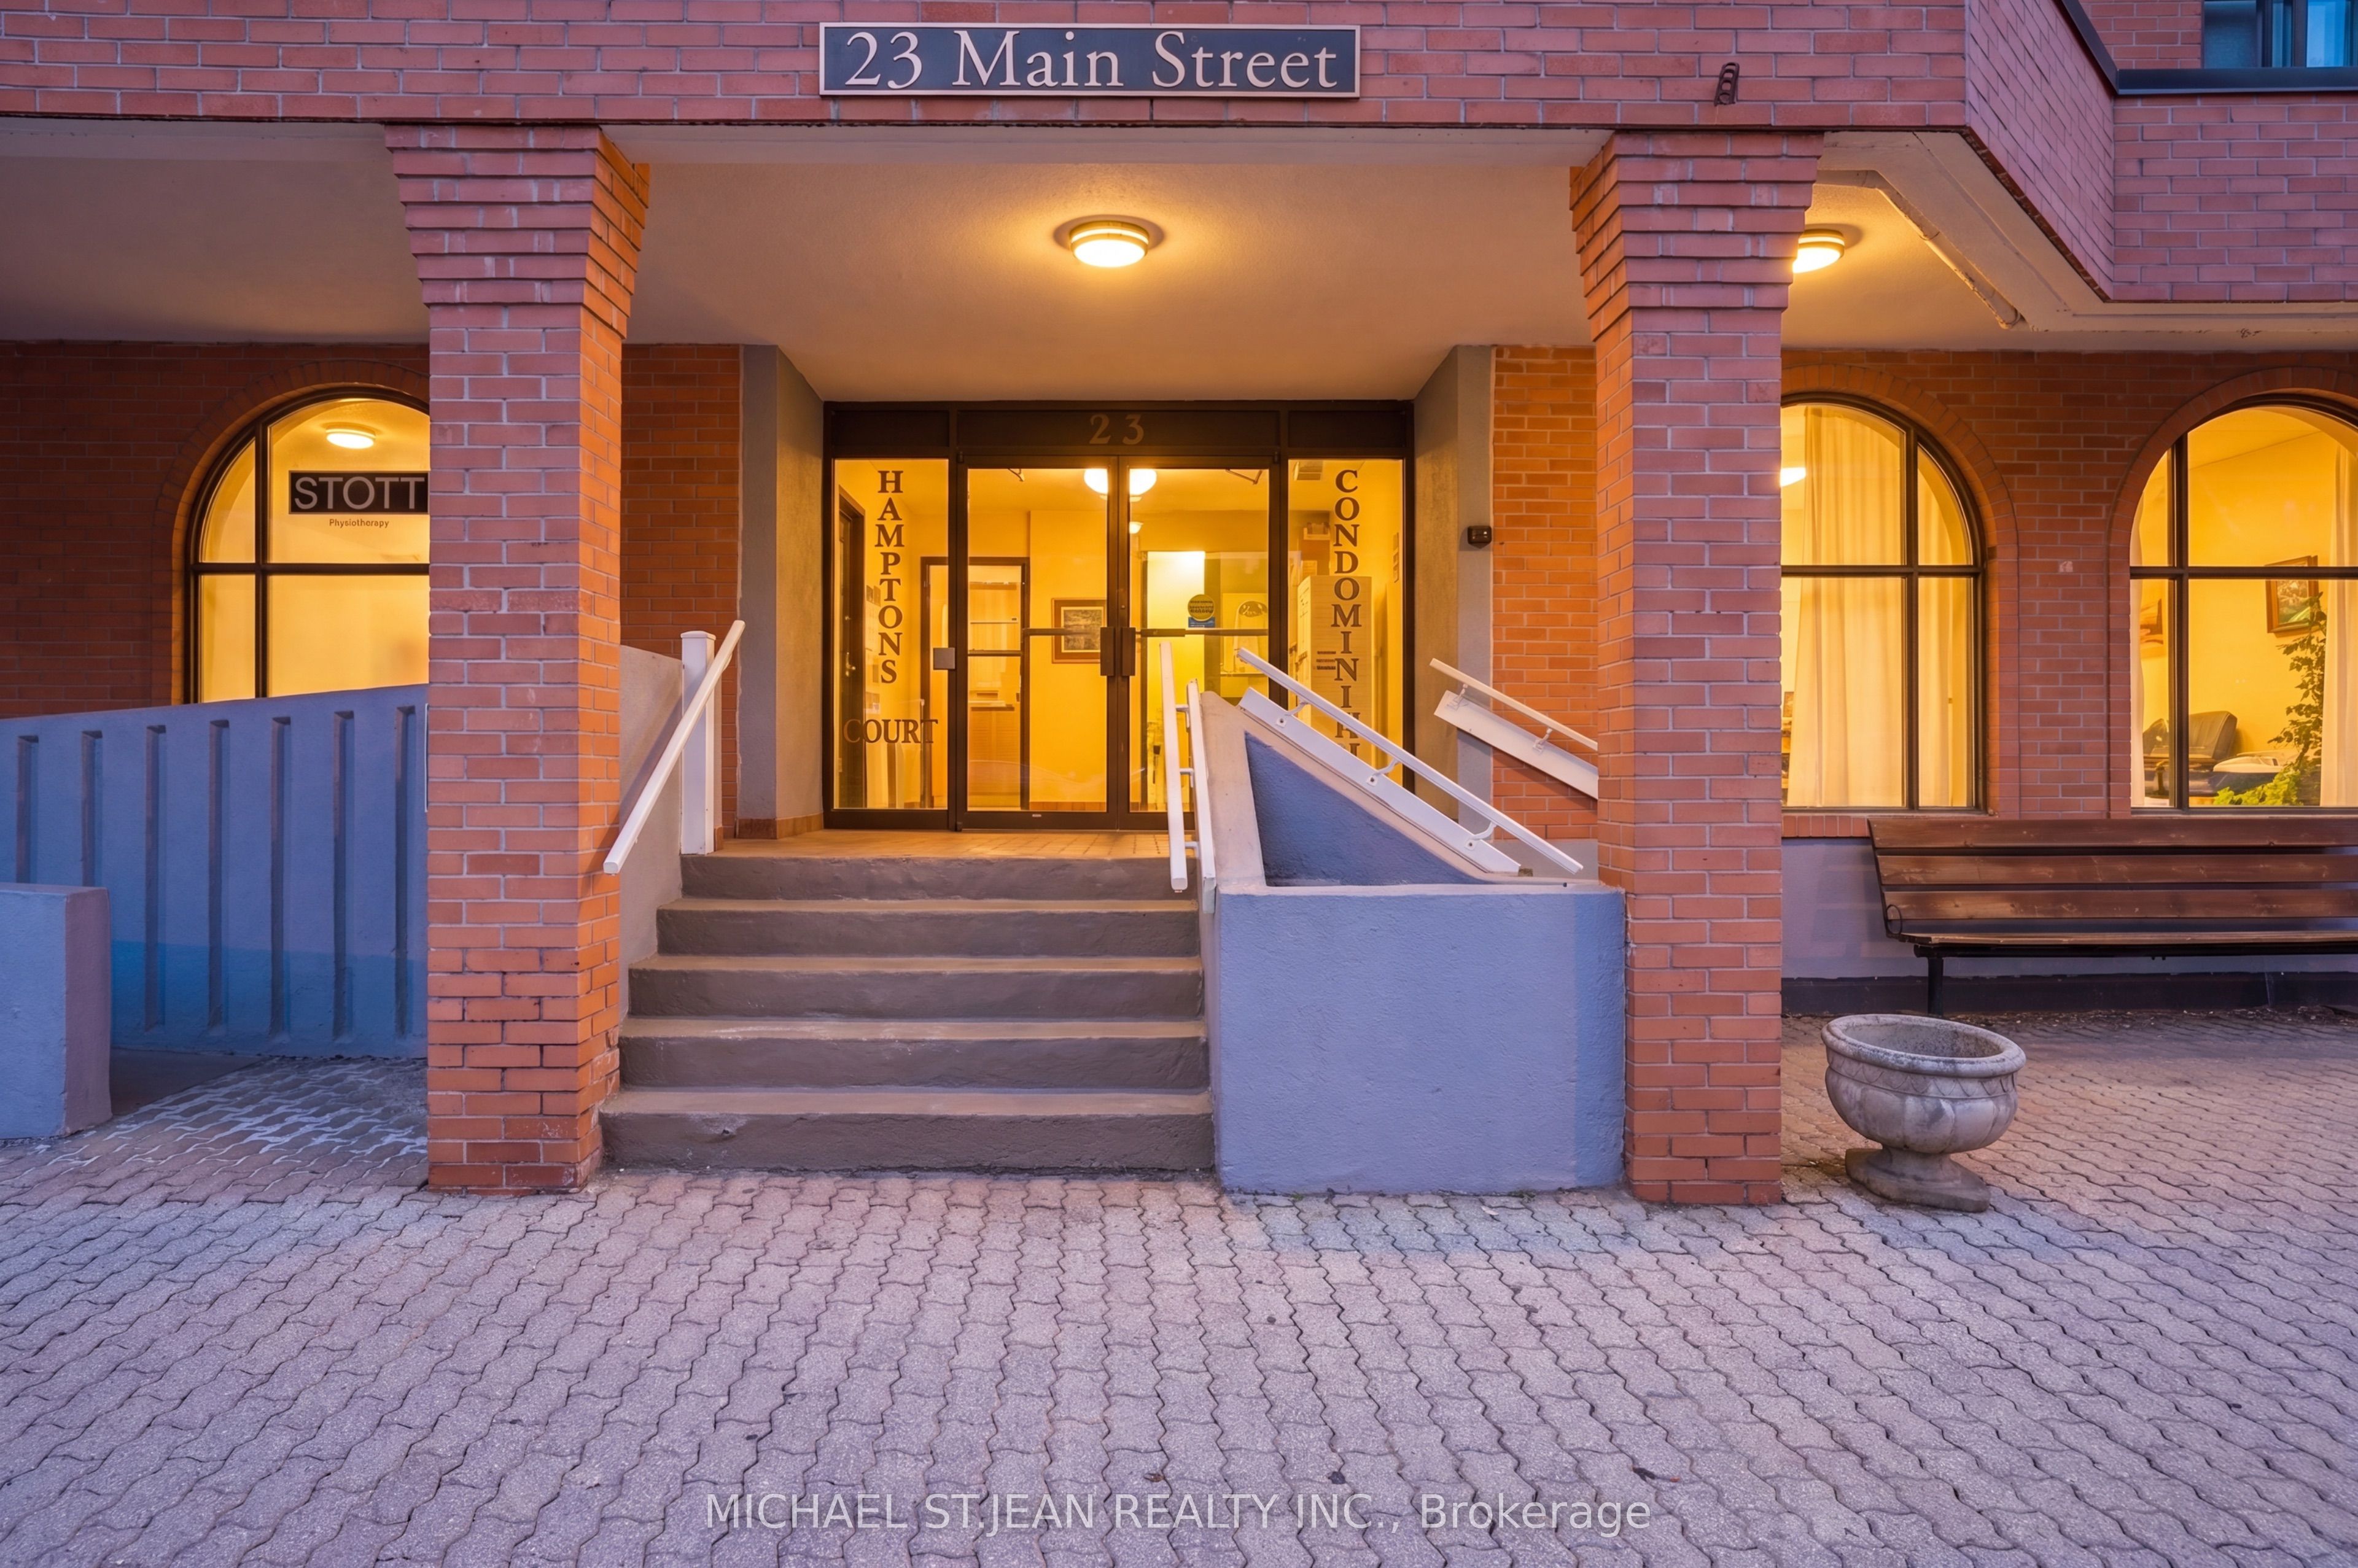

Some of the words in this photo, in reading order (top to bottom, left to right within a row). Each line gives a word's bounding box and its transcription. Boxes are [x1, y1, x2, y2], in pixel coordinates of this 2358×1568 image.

[846, 31, 924, 89] 23
[952, 30, 1124, 88] Main
[1151, 31, 1337, 88] Street
[1089, 414, 1144, 444] 23
[294, 476, 425, 510] STOTT
[329, 519, 389, 528] Physiotherapy
[874, 470, 905, 683] HAMPTONS
[1331, 469, 1362, 756] CONDOMINI
[843, 719, 938, 744] COURT
